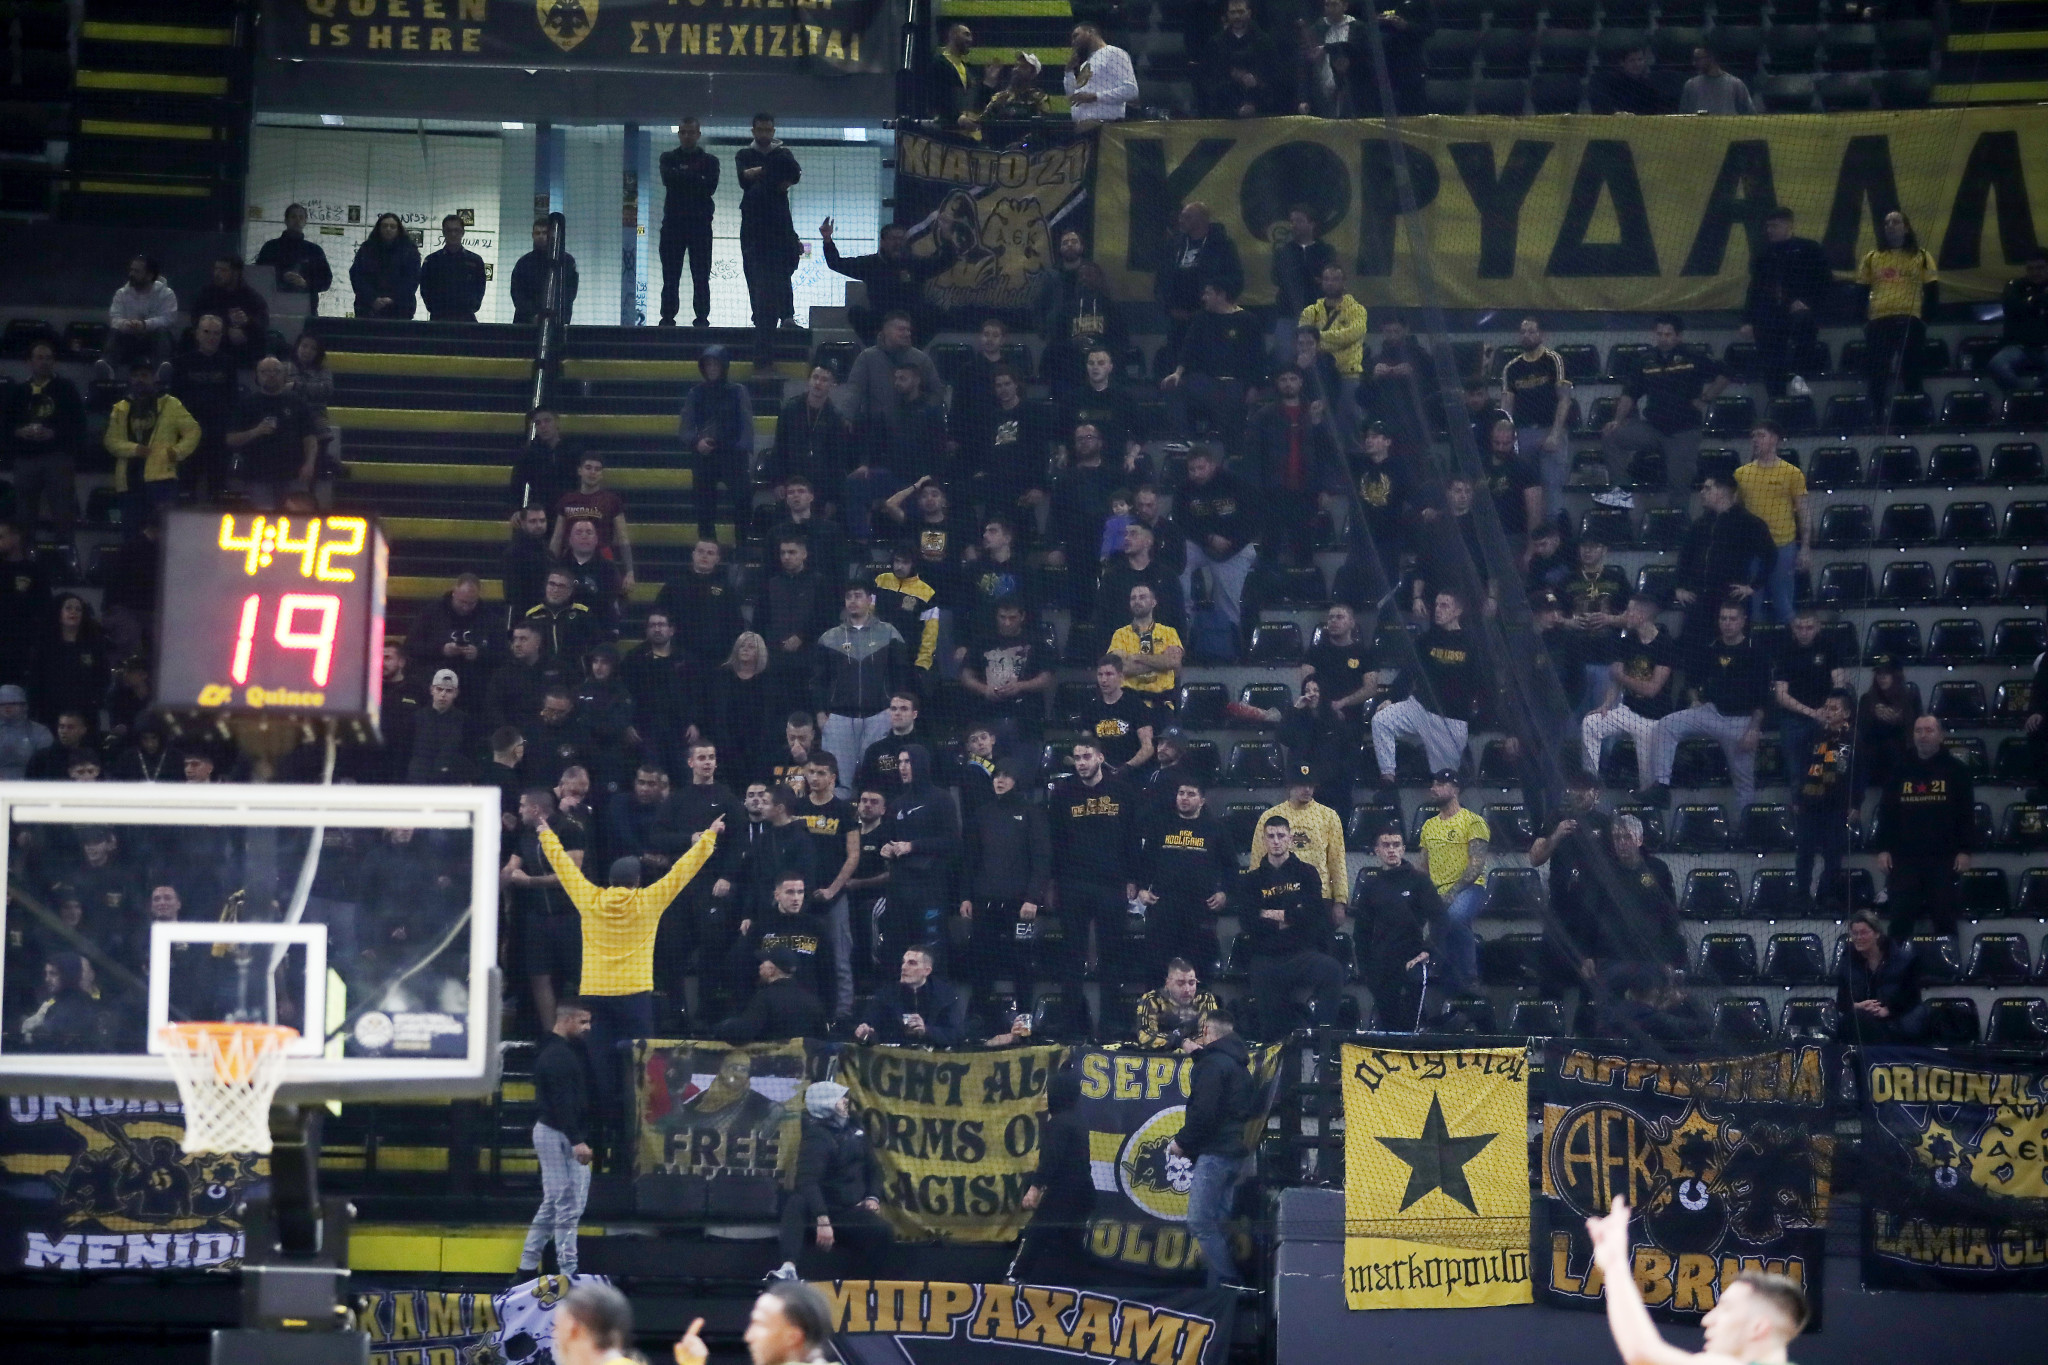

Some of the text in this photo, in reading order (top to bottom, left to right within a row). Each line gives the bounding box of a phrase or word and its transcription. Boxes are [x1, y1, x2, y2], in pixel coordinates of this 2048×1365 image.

[309, 23, 482, 51] IS HERE
[219, 514, 368, 582] 4:42
[231, 594, 341, 687] 19
[1871, 1065, 2038, 1105] ORIGINAL
[664, 1126, 781, 1168] FREE
[863, 1107, 987, 1163] ORMS
[1876, 1210, 1993, 1266] LAMIA
[1350, 1250, 1530, 1297] markopoulo
